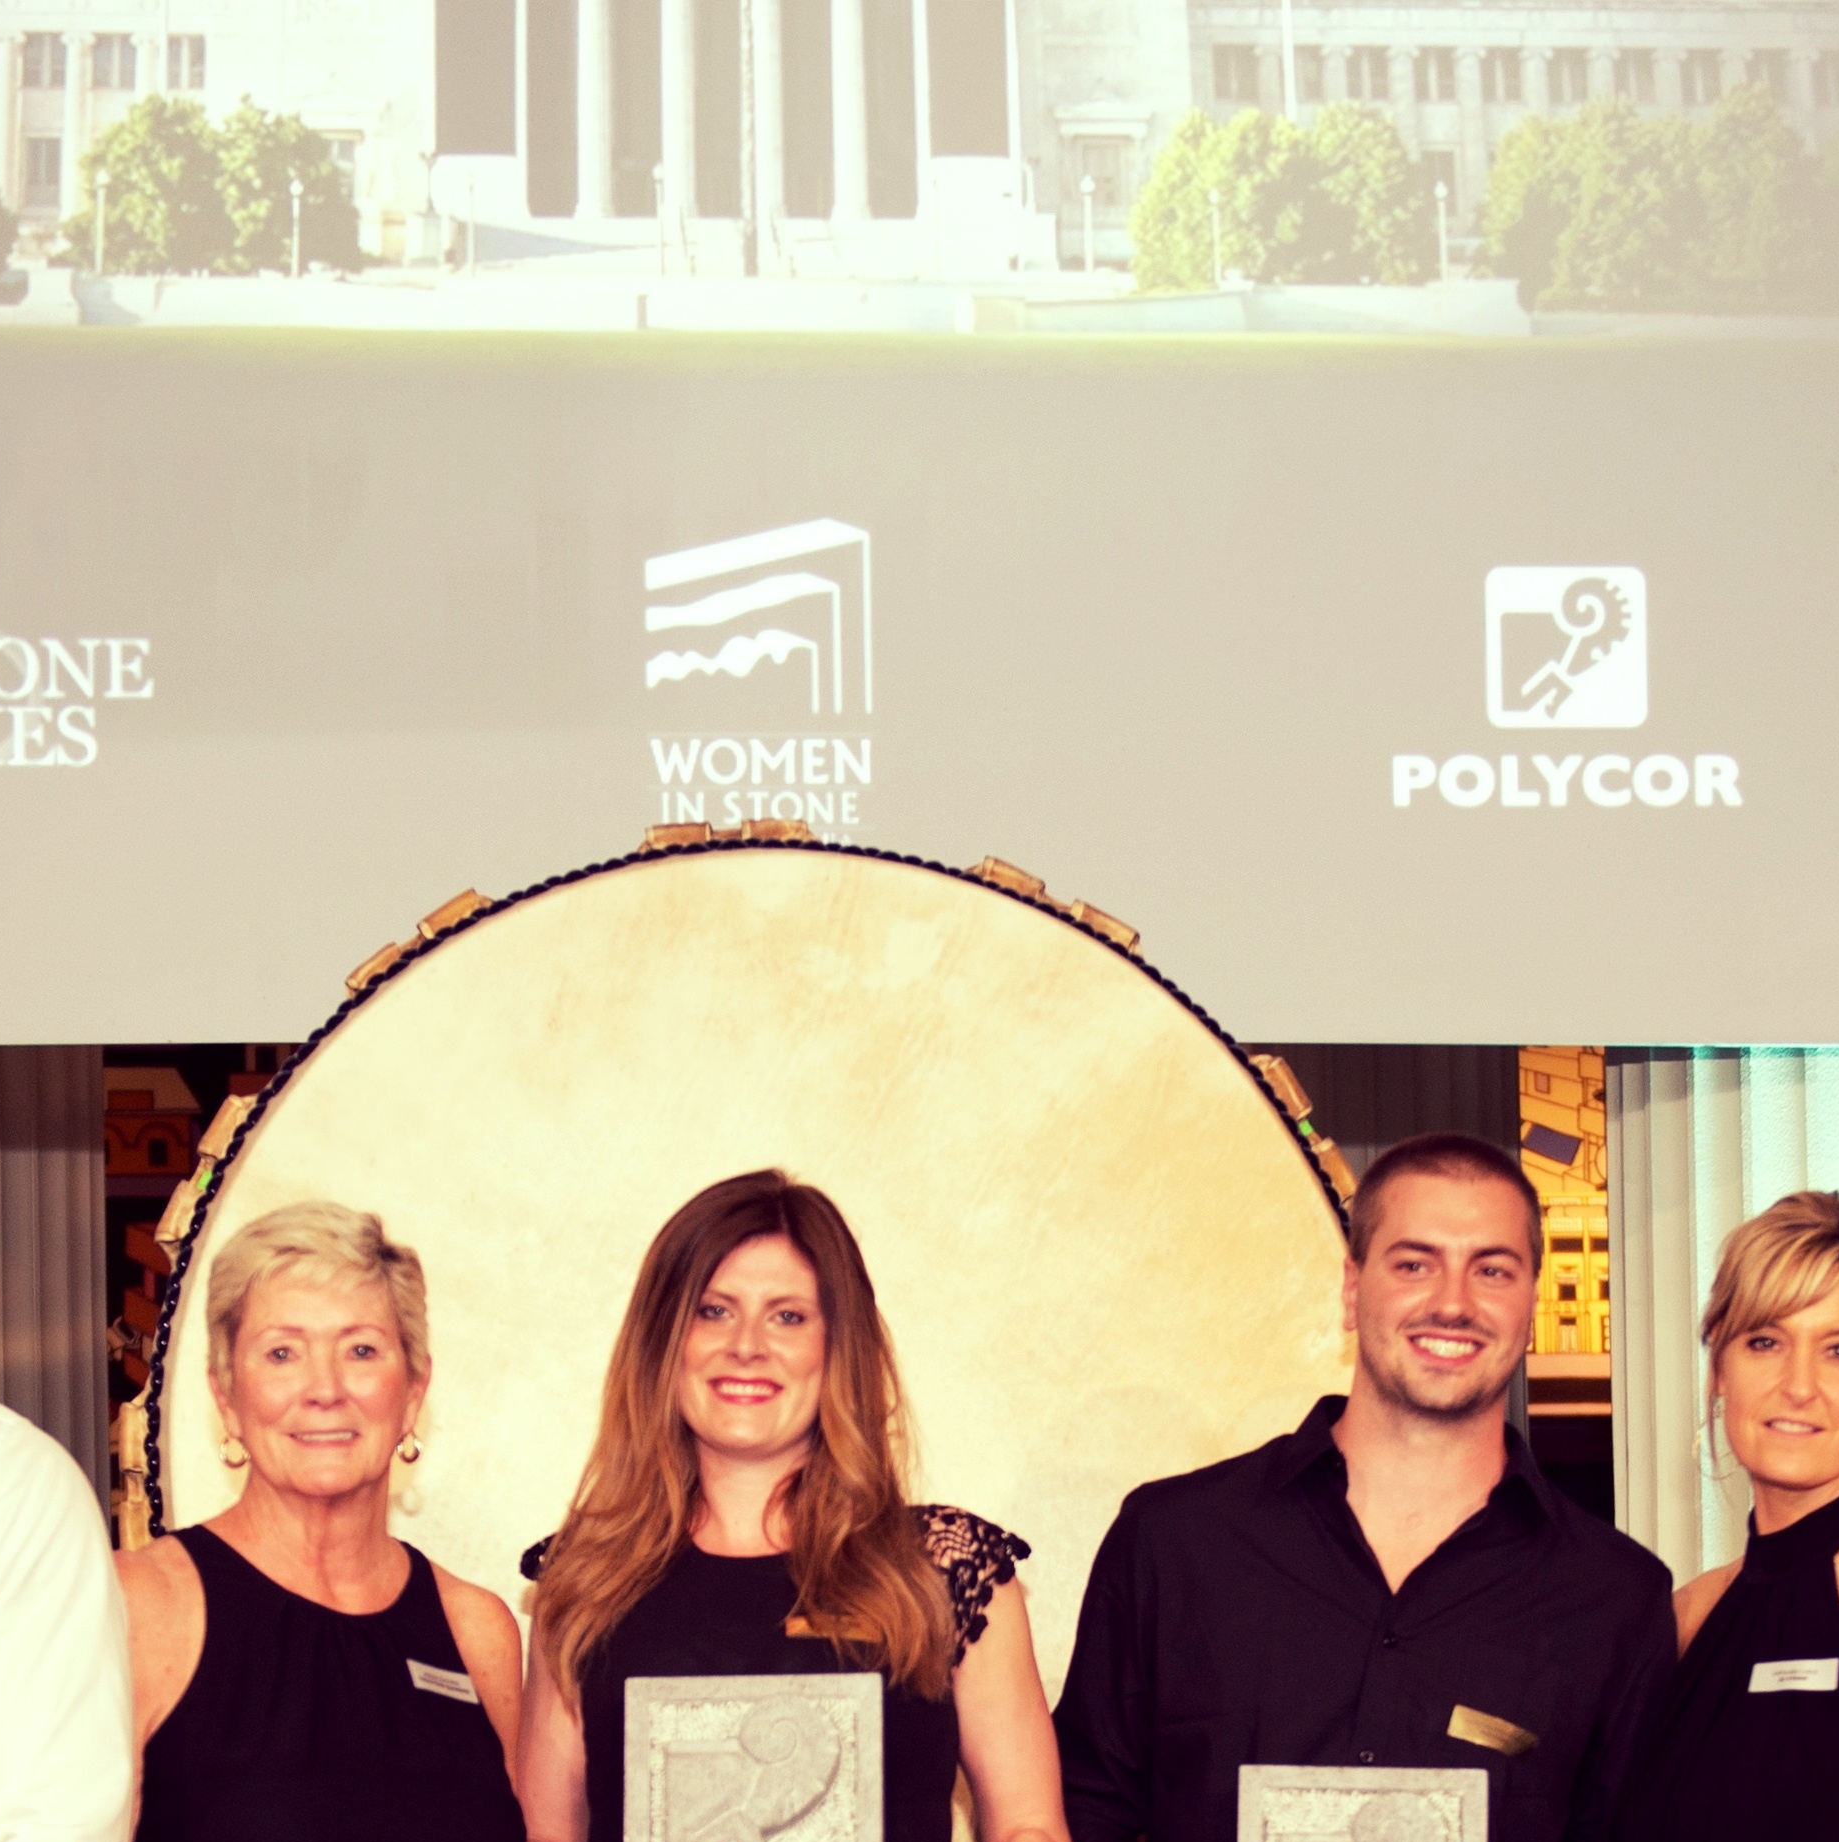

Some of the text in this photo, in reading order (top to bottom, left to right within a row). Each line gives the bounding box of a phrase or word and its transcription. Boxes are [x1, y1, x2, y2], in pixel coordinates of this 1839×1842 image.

[650, 738, 871, 785] WOMEN
[1392, 753, 1743, 808] POLYCOR
[661, 791, 860, 825] IN STONE
